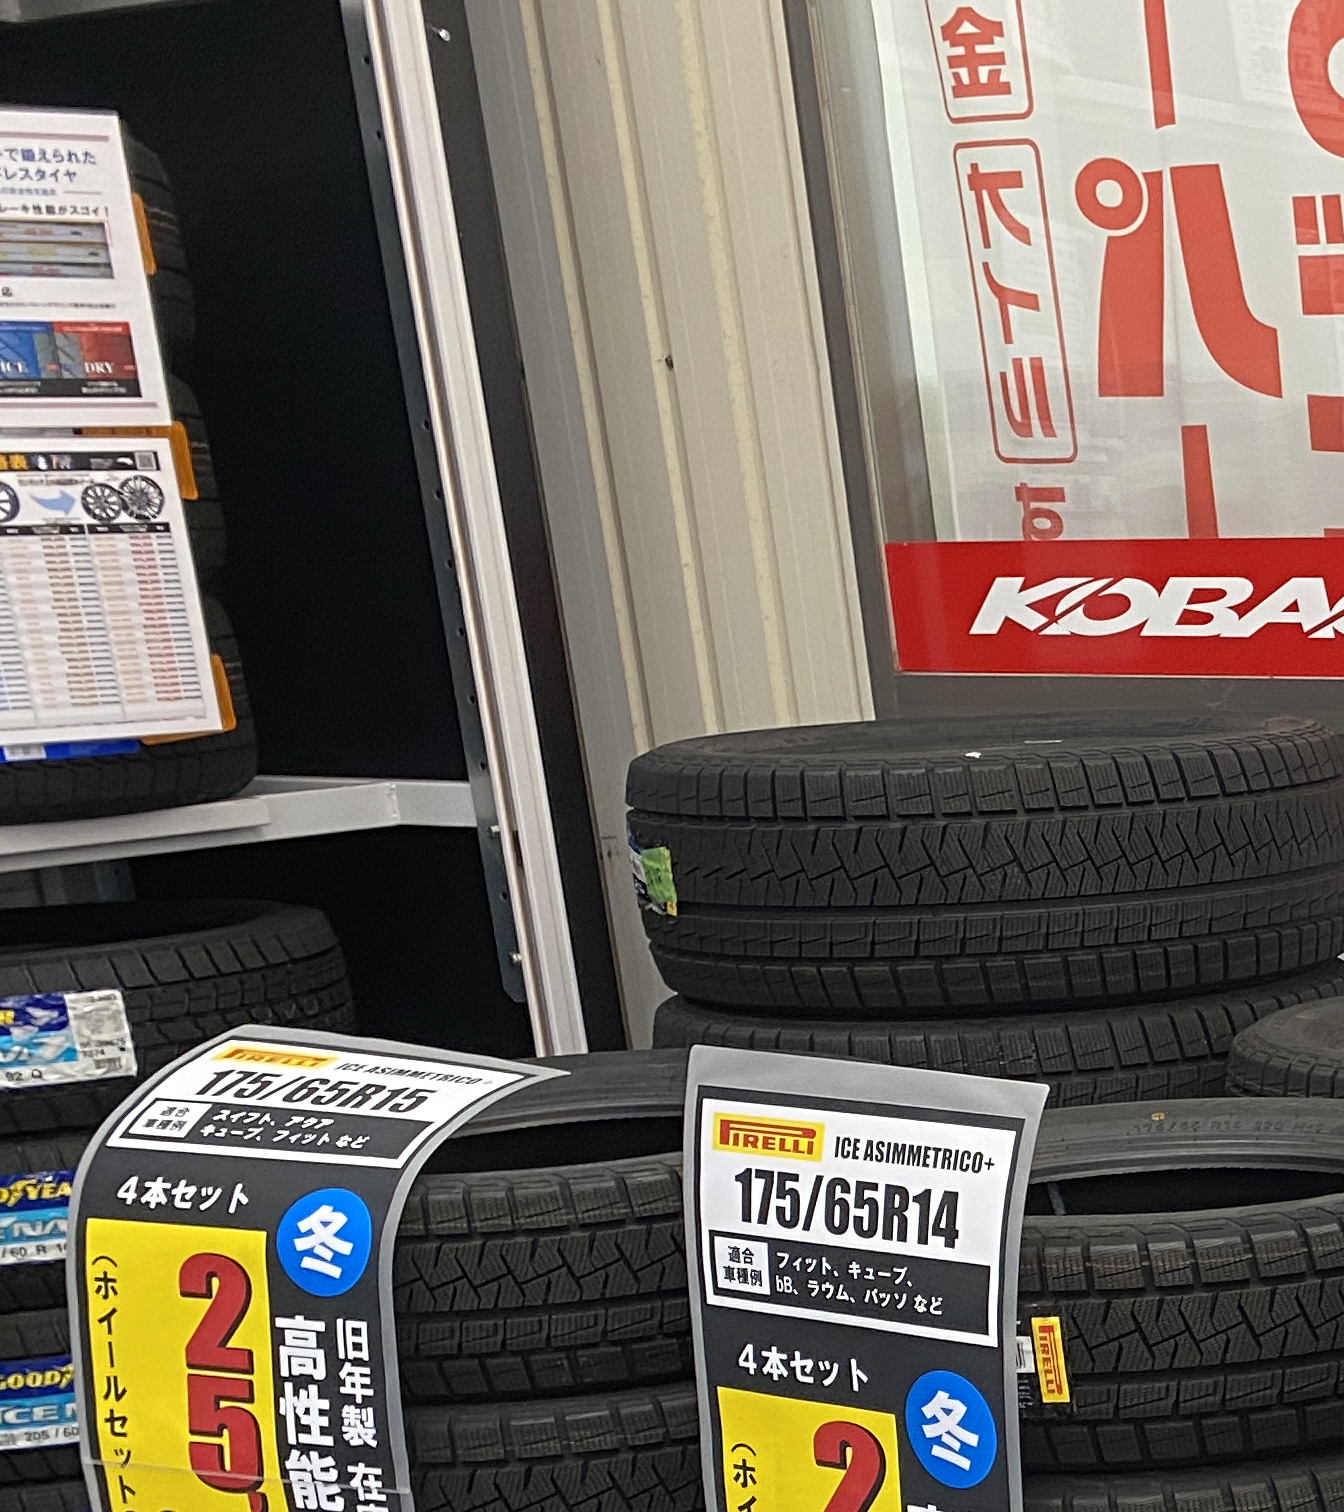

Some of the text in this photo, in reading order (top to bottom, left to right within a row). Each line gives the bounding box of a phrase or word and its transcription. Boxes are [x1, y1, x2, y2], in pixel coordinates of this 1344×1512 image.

[195, 1069, 438, 1114] 175/65R15
[719, 1118, 817, 1156] PIRELLI
[834, 1135, 863, 1162] ICE
[116, 1175, 250, 1214] 4本セット
[733, 1166, 961, 1250] 175/65R14
[294, 1204, 354, 1280] 冬
[726, 1244, 755, 1266] 適合
[722, 1265, 764, 1288] 車種例
[336, 1317, 379, 1449] 旧年製
[738, 1343, 870, 1393] 4本セット
[1038, 1324, 1064, 1396] PIRELLI
[920, 1389, 979, 1472] 冬
